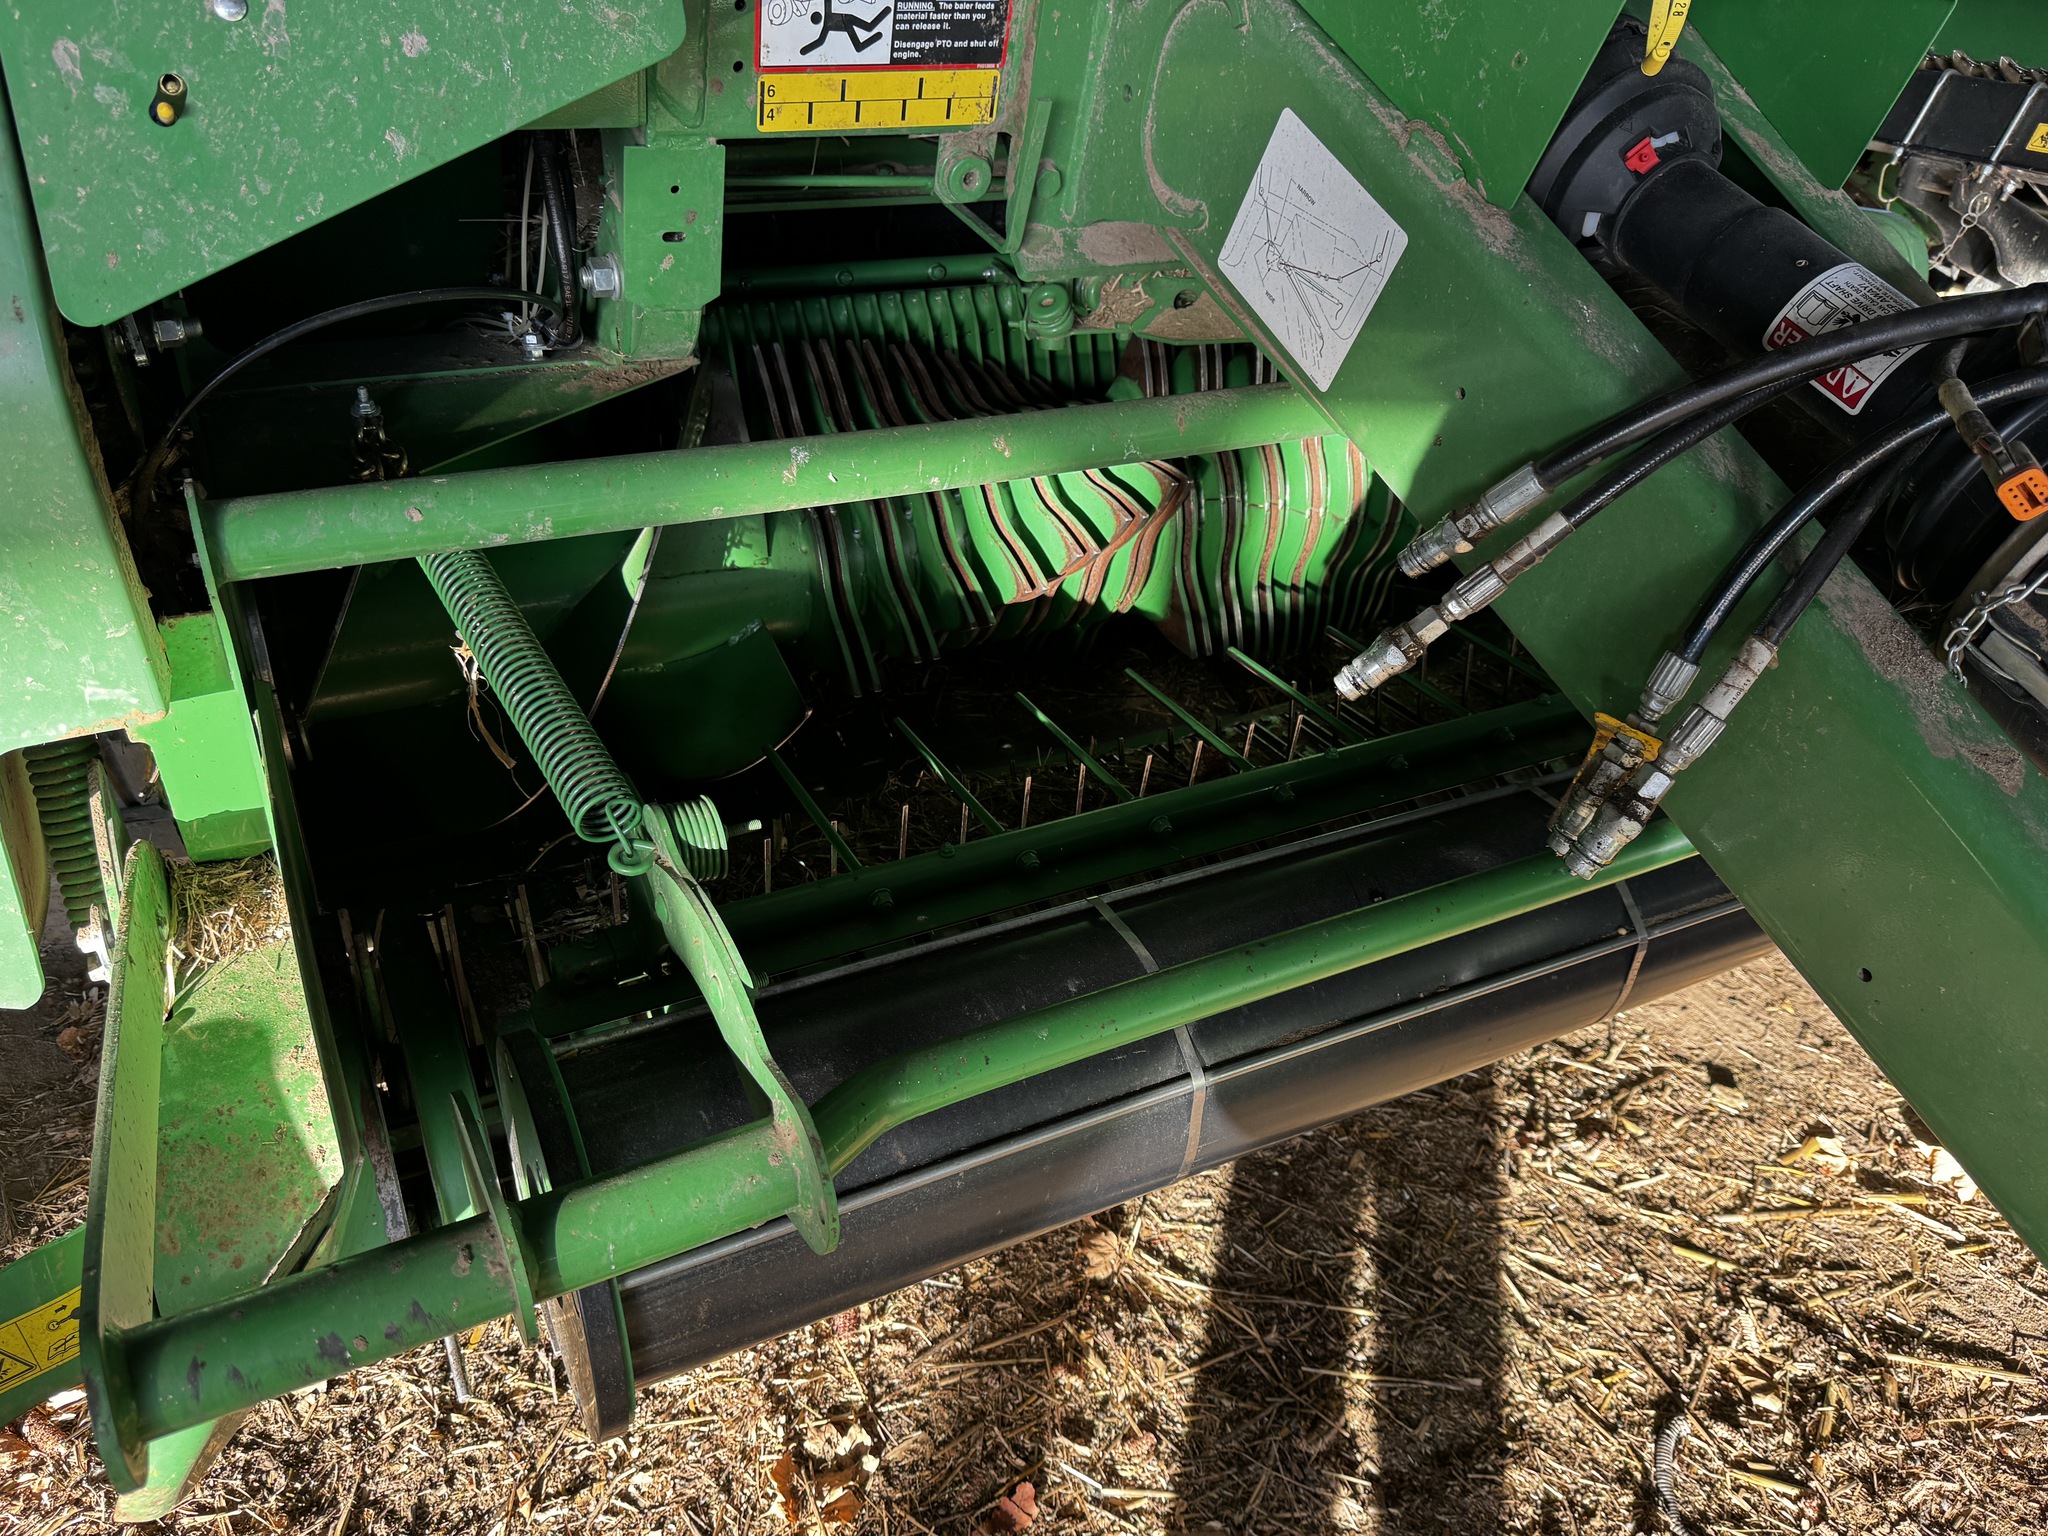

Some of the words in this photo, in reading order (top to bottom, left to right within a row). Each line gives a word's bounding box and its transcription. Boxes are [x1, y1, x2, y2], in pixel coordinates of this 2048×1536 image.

[896, 2, 935, 11] RUNNING.
[939, 2, 953, 10] The
[954, 2, 973, 10] baler
[975, 2, 995, 10] feeds
[895, 12, 928, 20] material
[930, 12, 952, 20] faster
[953, 12, 970, 20] than
[972, 13, 986, 21] you
[912, 22, 940, 30] release
[943, 22, 951, 30] it.
[893, 40, 934, 50] Disengage
[936, 39, 952, 48] PTO
[953, 39, 968, 47] and
[969, 39, 986, 47] shut
[988, 39, 999, 47] off
[893, 51, 921, 60] engine.
[766, 85, 776, 97] 6
[766, 109, 775, 121] 4
[1296, 183, 1316, 205] NARROW
[1825, 279, 1852, 299] SHAFT
[1843, 280, 1862, 294] DEATH
[1857, 282, 1890, 303] AWAY!
[1265, 289, 1276, 304] WIDE
[1859, 291, 1879, 306] CAUSE
[1881, 291, 1907, 309] PERATE
[1850, 296, 1876, 315] DRIVE
[1877, 304, 1890, 314] CAN
[1771, 320, 1846, 386] DER
